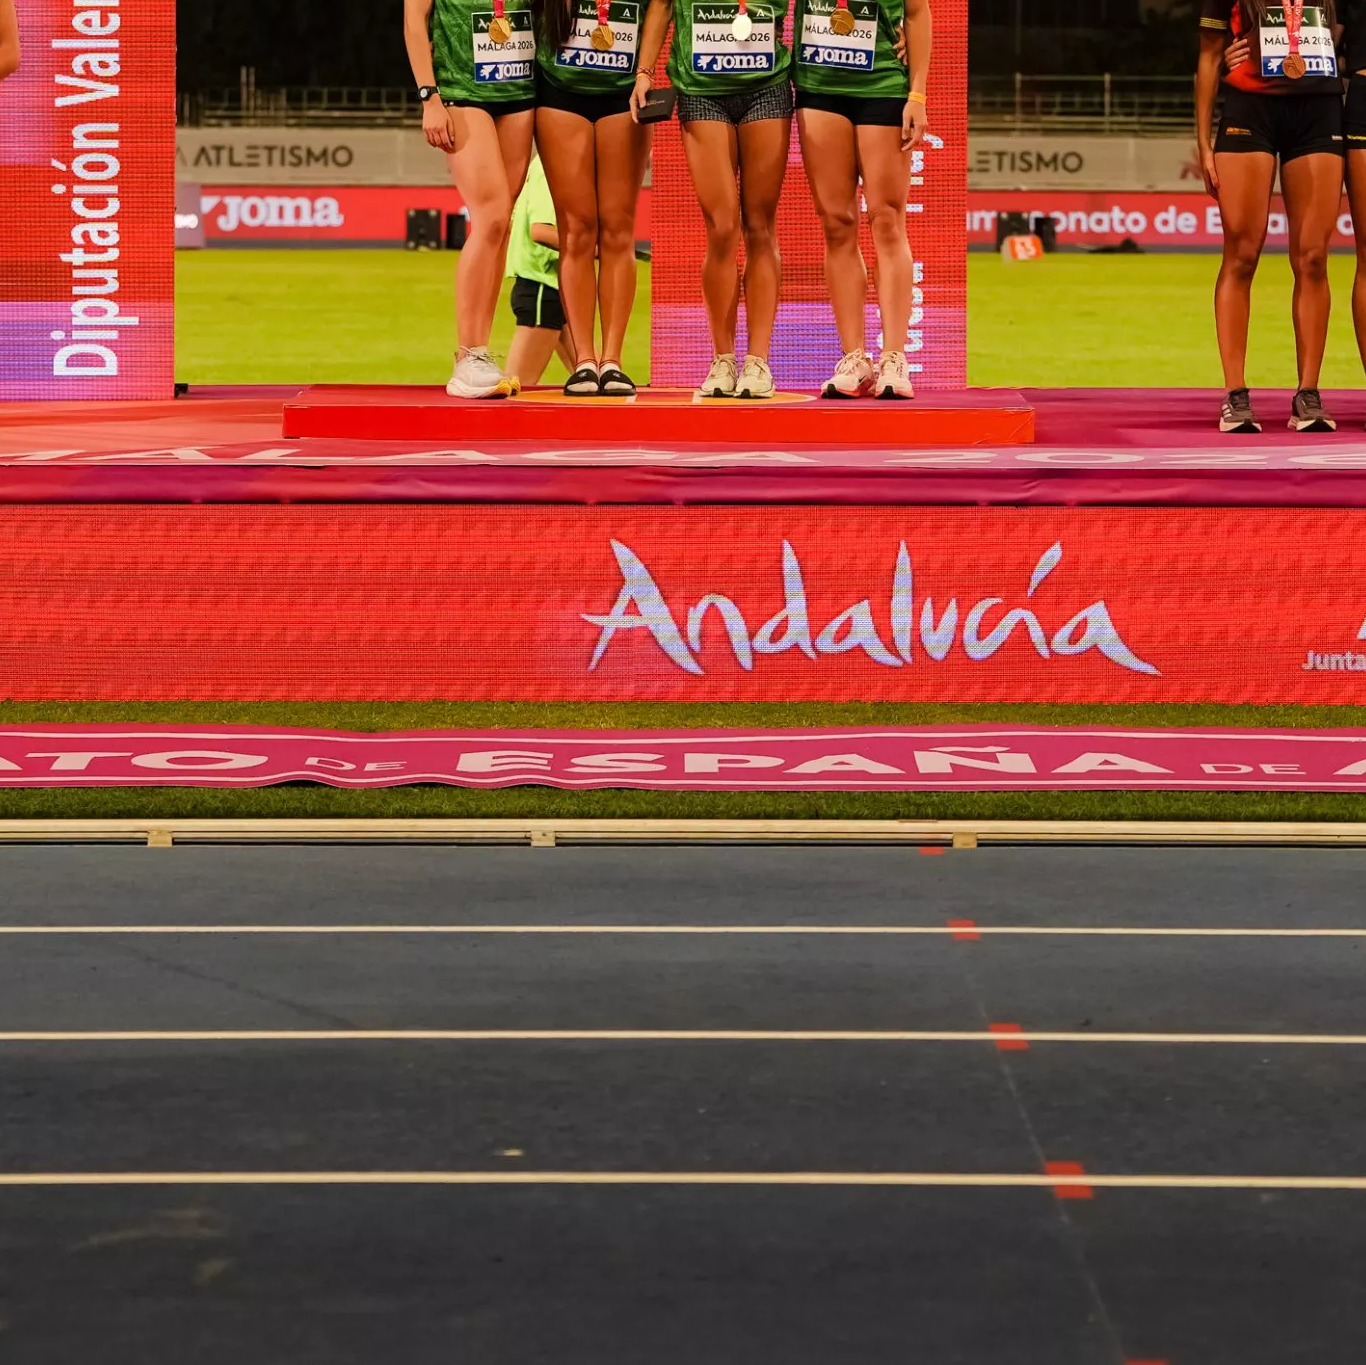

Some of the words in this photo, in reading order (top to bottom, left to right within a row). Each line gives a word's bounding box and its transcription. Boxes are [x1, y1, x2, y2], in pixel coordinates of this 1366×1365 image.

[477, 40, 516, 52] MÁLAGA
[517, 41, 533, 50] 2026
[615, 32, 633, 42] 026
[1264, 35, 1310, 46] MÁLGA
[192, 145, 354, 168] ATLETISMO
[967, 150, 1084, 174] ETISMO
[1154, 205, 1197, 234] de
[52, 123, 139, 375] Diputación
[580, 539, 1163, 678] Andalucía
[306, 756, 408, 772] DE
[456, 746, 1176, 775] ESPAÑA
[1200, 763, 1307, 775] DE
